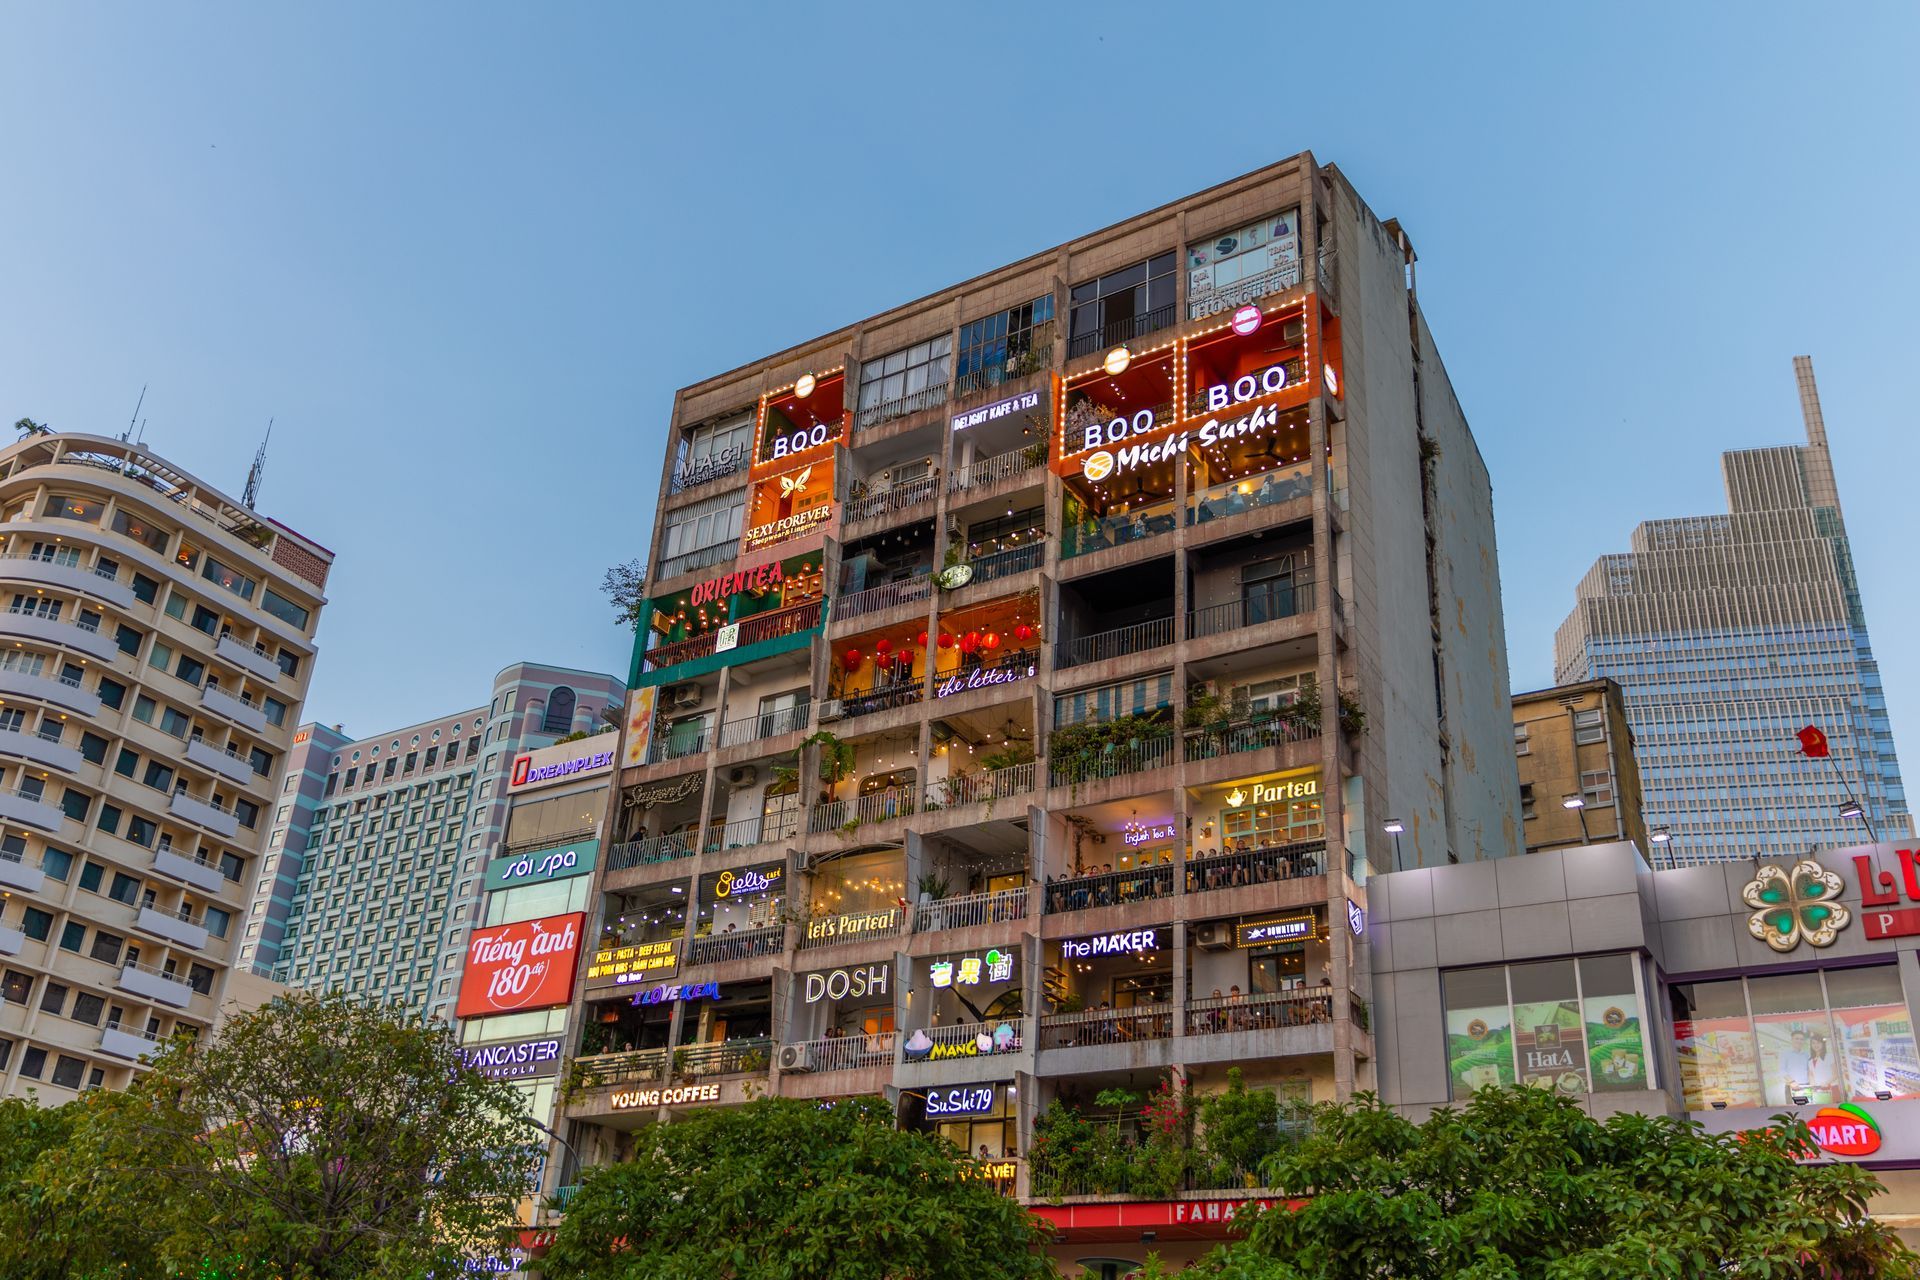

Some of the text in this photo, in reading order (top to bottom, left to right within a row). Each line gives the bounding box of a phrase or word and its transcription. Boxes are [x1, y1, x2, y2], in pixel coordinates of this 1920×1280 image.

[1208, 366, 1286, 411] BOO
[954, 394, 1038, 430] DELIGHT KAFE & TEA
[773, 424, 827, 459] BOO
[1084, 408, 1154, 450] BOO
[1118, 403, 1278, 474] Michi Sushi
[683, 463, 736, 487] COSMETICS
[746, 505, 830, 540] SEXY FOREVER
[691, 560, 784, 607] ORIENTEA
[938, 676, 965, 698] the
[527, 751, 613, 783] DREAMPLEX
[1253, 780, 1316, 804] Partea
[1152, 828, 1165, 839] Tea
[537, 850, 576, 877] spa
[839, 909, 895, 936] Partea!
[1267, 922, 1306, 936] DOWNTOWN
[472, 928, 527, 966] Tiếng
[596, 942, 673, 964] PIZZA PASTA BEEF STEAK
[1062, 930, 1154, 958] the MAKER
[487, 961, 545, 998] 180 độ
[642, 984, 681, 1004] LOVE
[680, 981, 720, 1000] KEM
[806, 964, 888, 1004] DOSH
[611, 1084, 720, 1108] YOUNG COFFEE
[1809, 1124, 1870, 1146] MART
